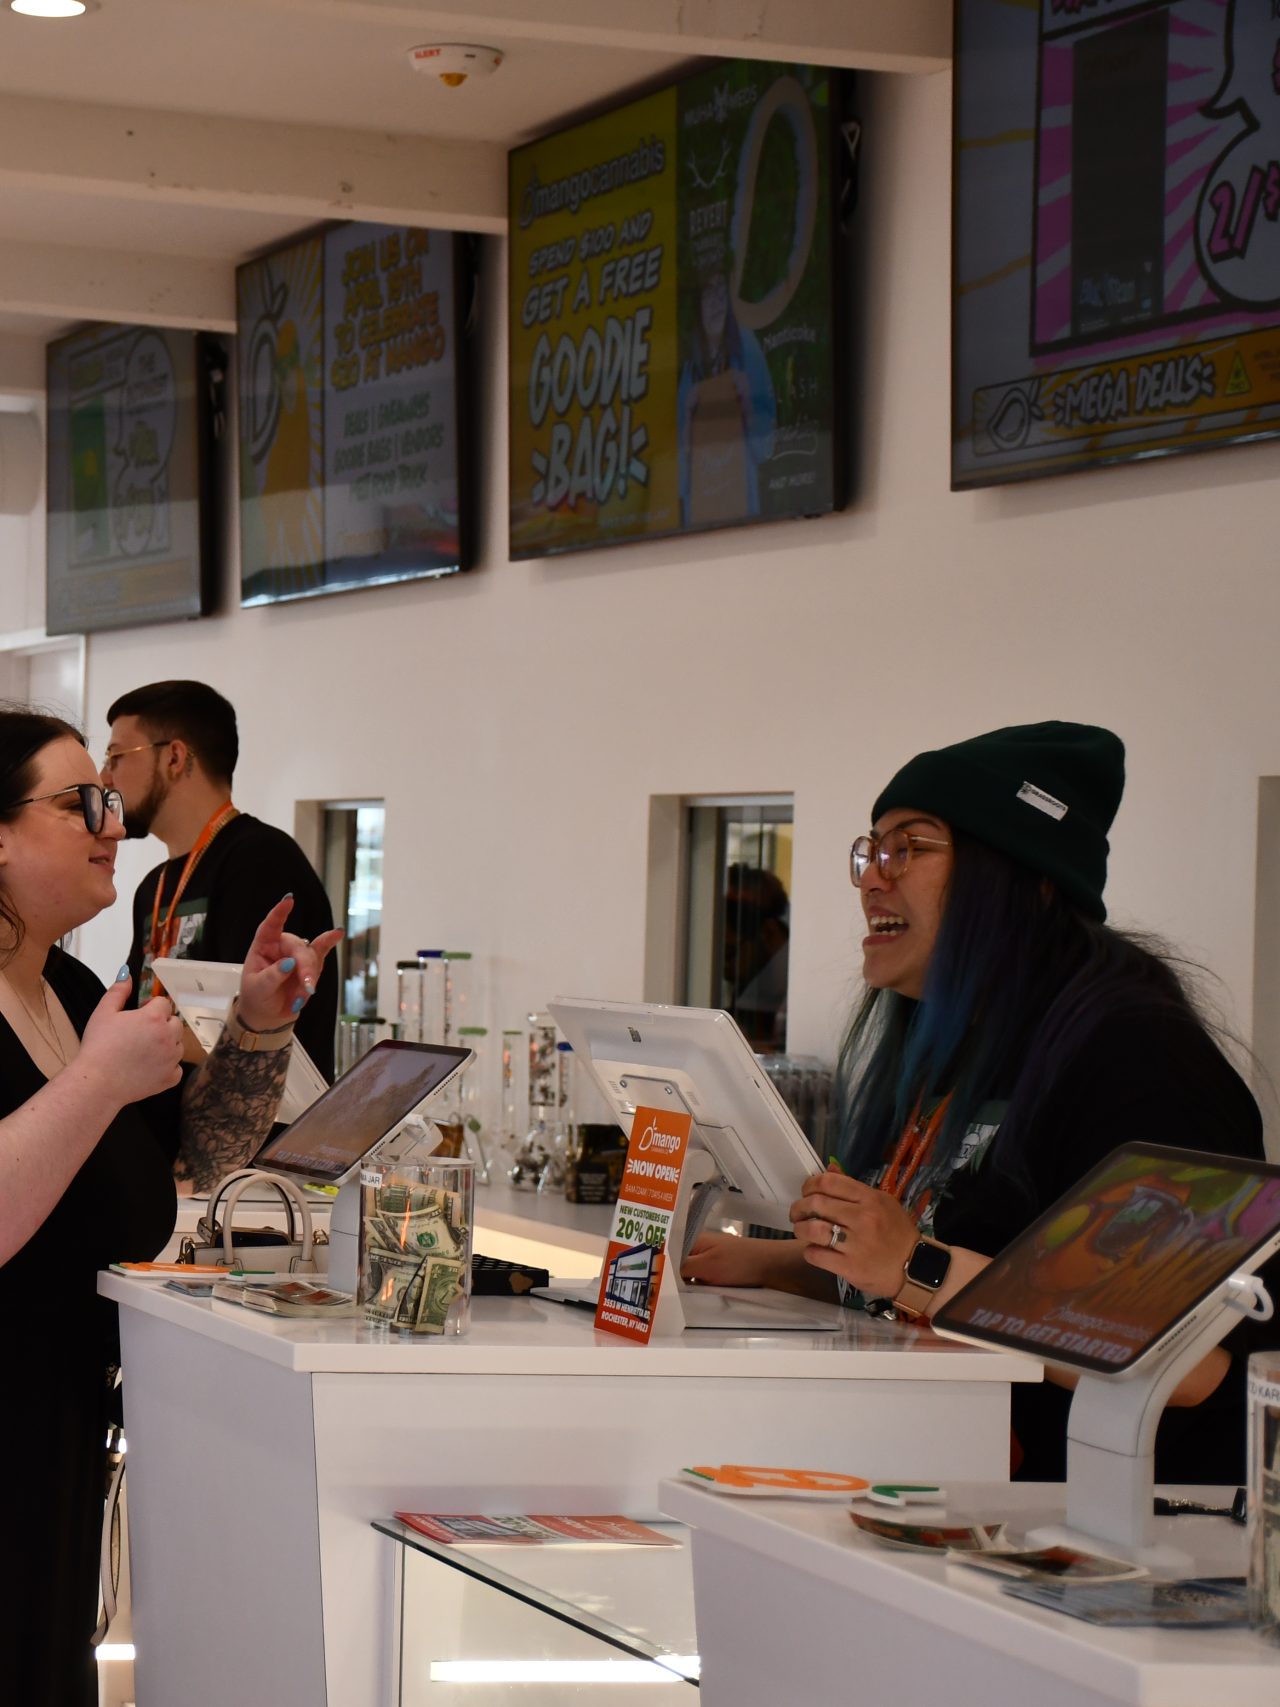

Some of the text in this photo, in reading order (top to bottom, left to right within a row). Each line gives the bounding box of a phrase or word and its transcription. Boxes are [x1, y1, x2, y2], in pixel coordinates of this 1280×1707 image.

[535, 134, 665, 218] mangocannabis
[529, 237, 577, 278] SPEND
[580, 223, 615, 263] $100
[619, 208, 653, 250] AND
[522, 243, 664, 328] GET A FREE
[528, 306, 653, 430] GOODIE
[1064, 370, 1129, 427] MEGA
[1135, 354, 1203, 414] DEALS
[546, 402, 632, 513] BAG!
[632, 1160, 677, 1182] NOW OPEN
[651, 1132, 681, 1154] mango
[368, 1176, 380, 1184] JAR
[616, 1217, 667, 1248] 20% OFF
[620, 1205, 670, 1225] NEW CUSTOMERS GET
[970, 1307, 1133, 1364] TAP TO GET STARTED
